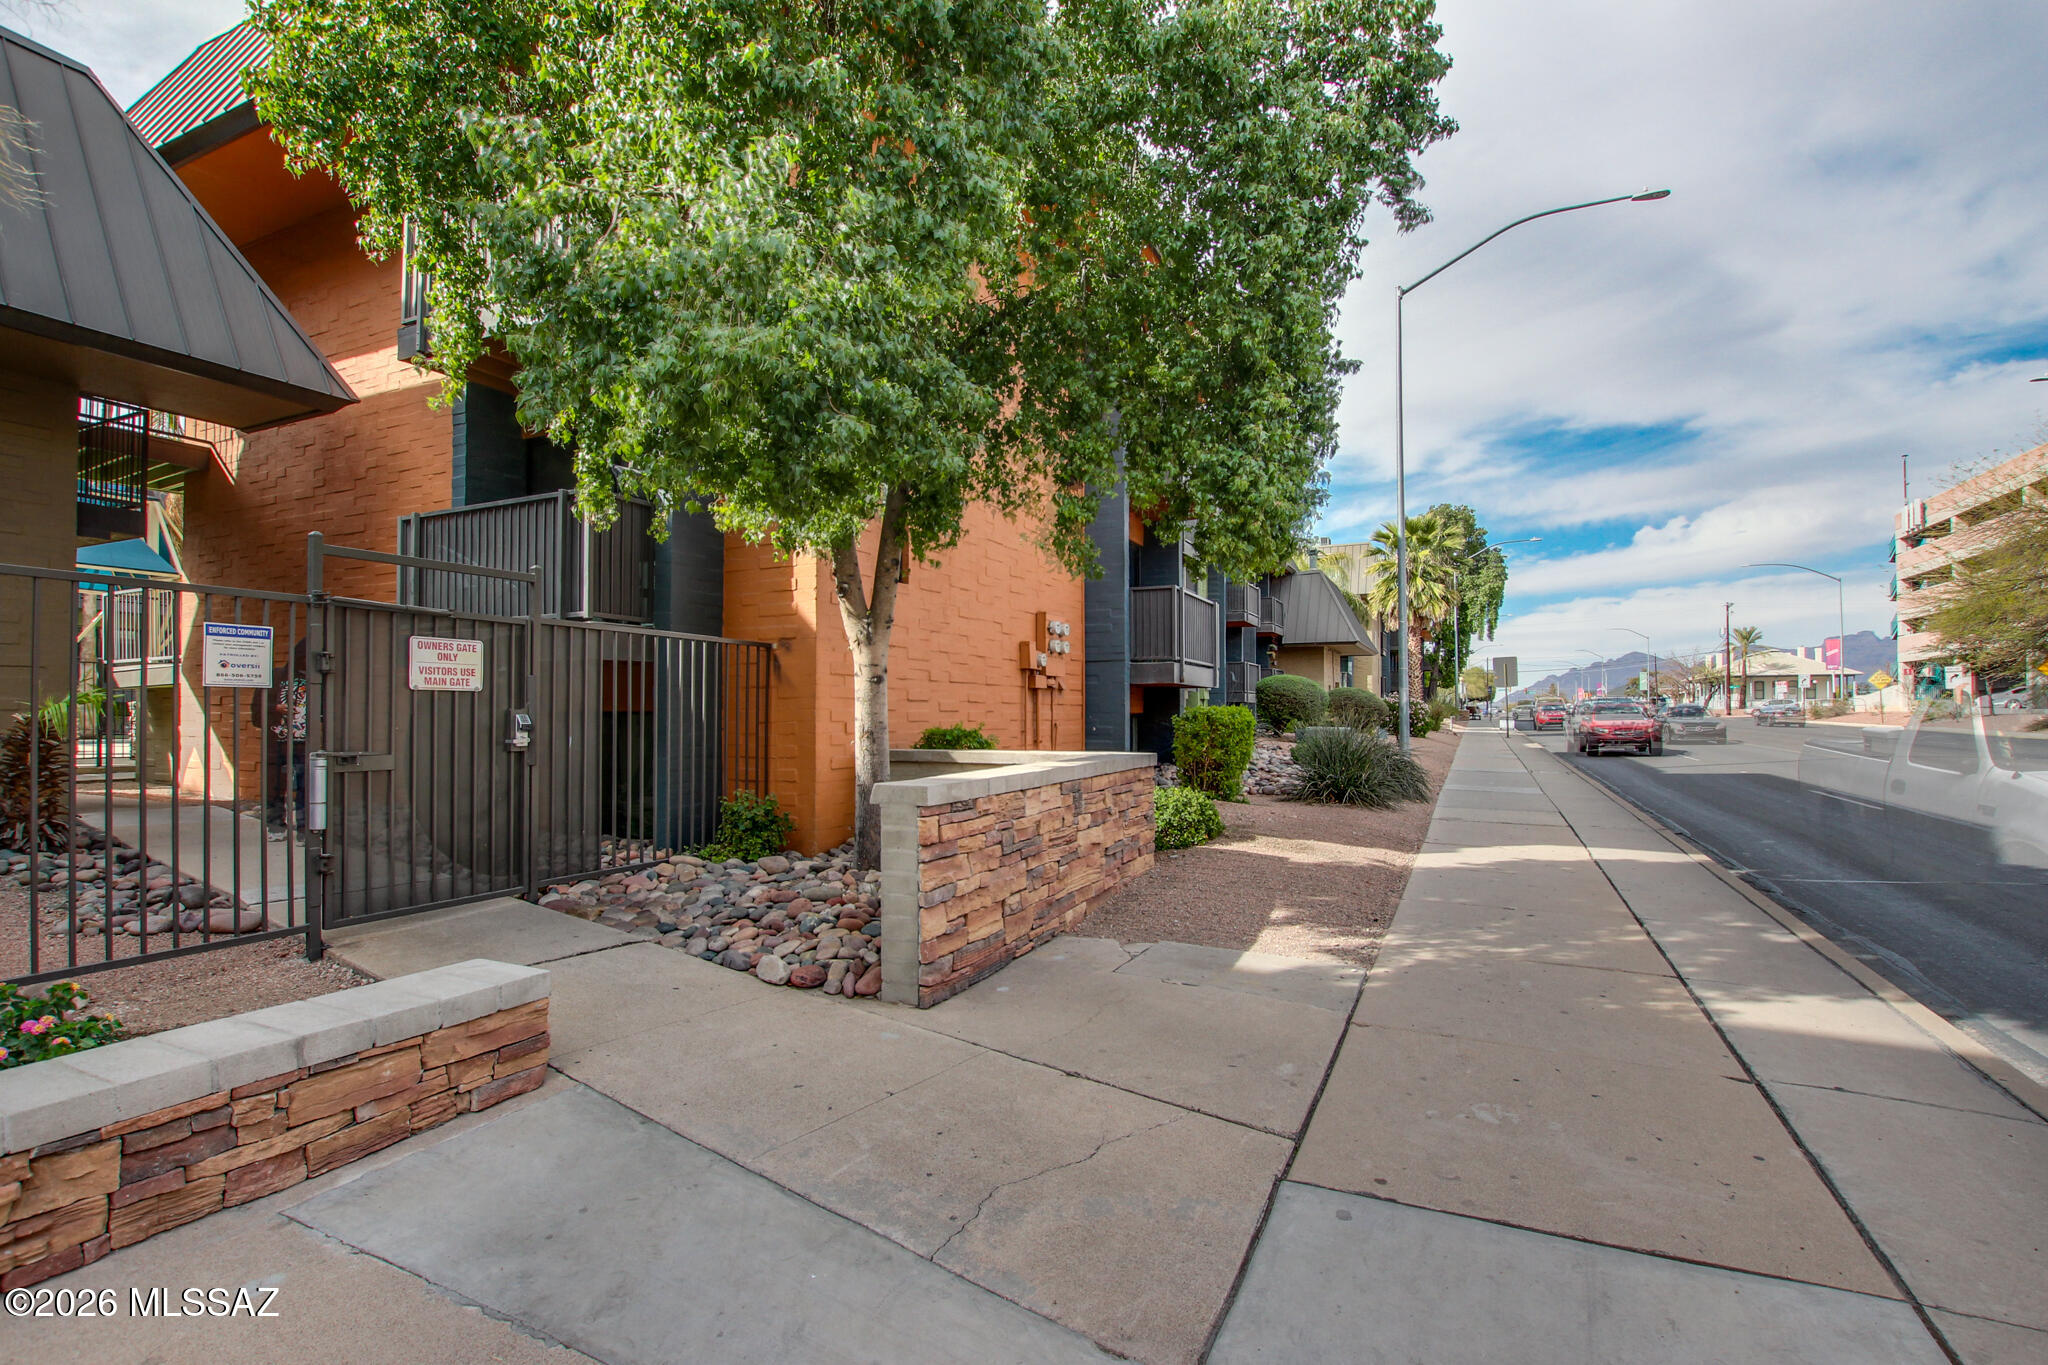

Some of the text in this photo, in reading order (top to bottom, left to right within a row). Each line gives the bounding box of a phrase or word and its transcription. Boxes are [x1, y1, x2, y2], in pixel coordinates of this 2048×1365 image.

[417, 640, 477, 652] OWNERS GATE
[437, 653, 458, 661] ONLY
[418, 666, 476, 677] VISITORS USE
[424, 676, 470, 686] MAIN GATE
